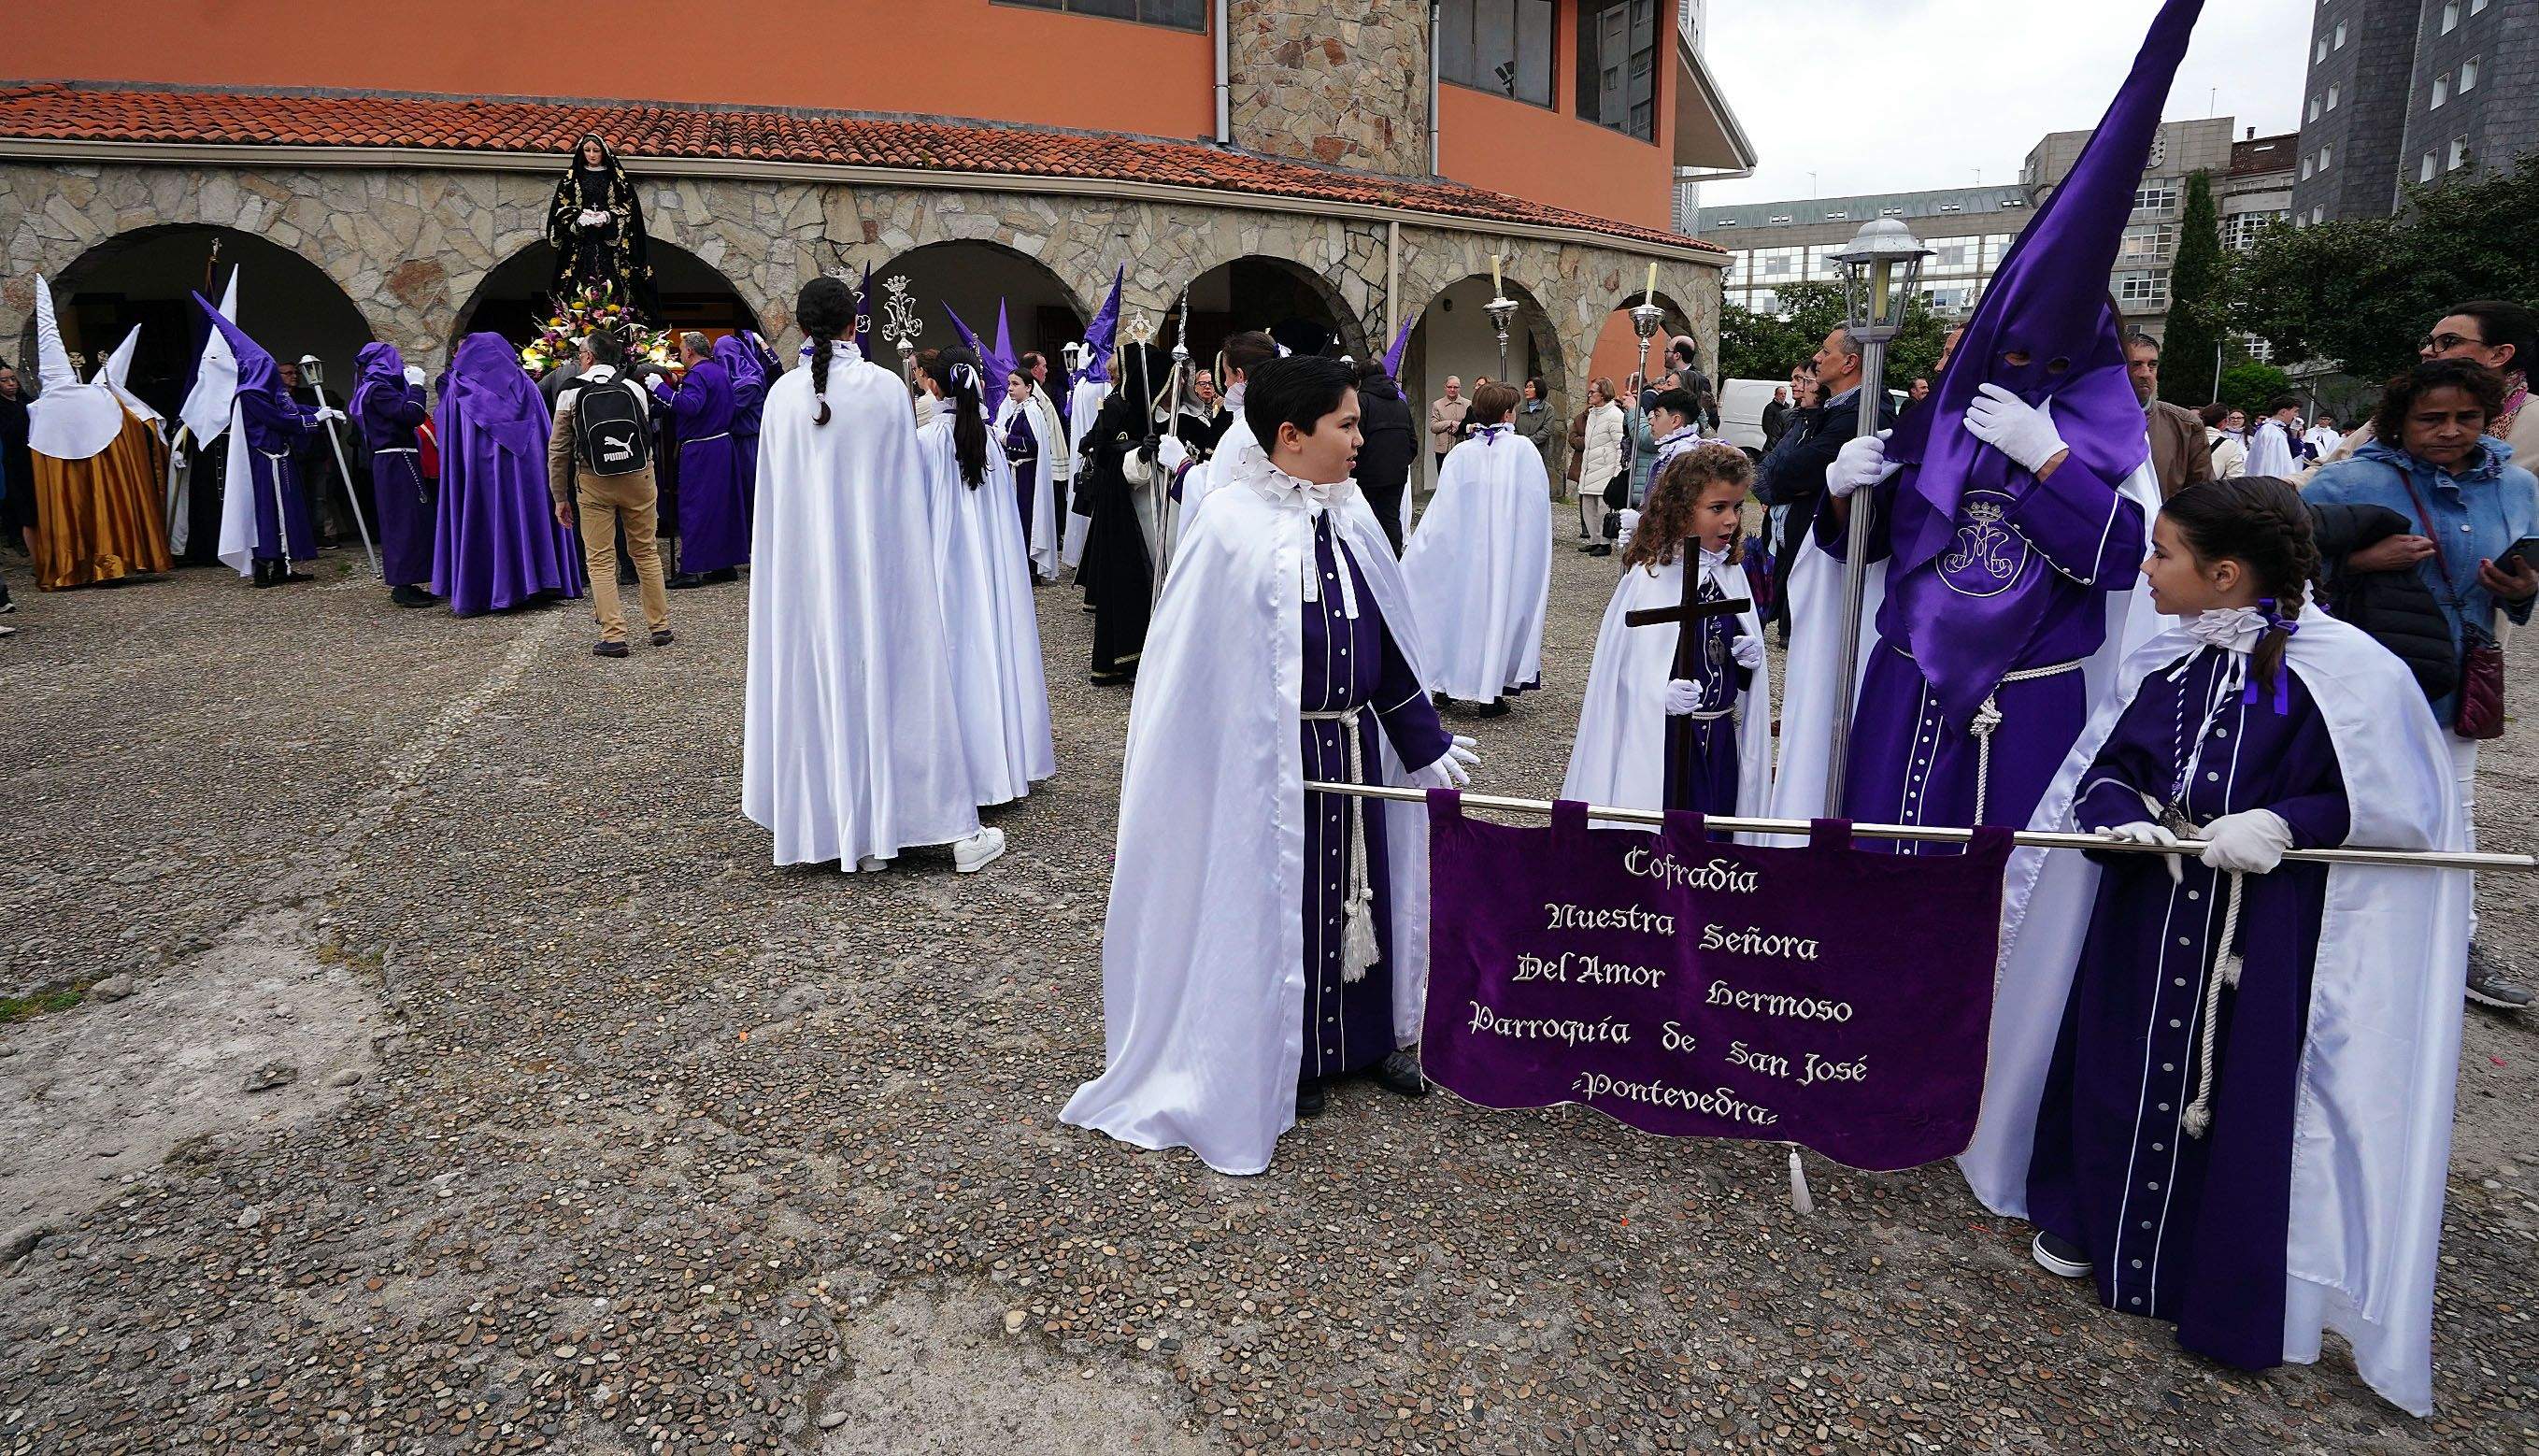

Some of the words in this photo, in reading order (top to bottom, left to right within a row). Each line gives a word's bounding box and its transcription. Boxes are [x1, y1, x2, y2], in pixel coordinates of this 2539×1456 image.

[604, 450, 629, 462] PUMA
[1624, 845, 1759, 893] Cofradía
[1544, 903, 1676, 936] Nuestra
[1698, 923, 1819, 961] Señora
[1512, 951, 1576, 982] Del
[1576, 955, 1666, 989] Amor
[1662, 1021, 1696, 1053] de
[1724, 1040, 1790, 1078] San
[1795, 1053, 1868, 1087] José
